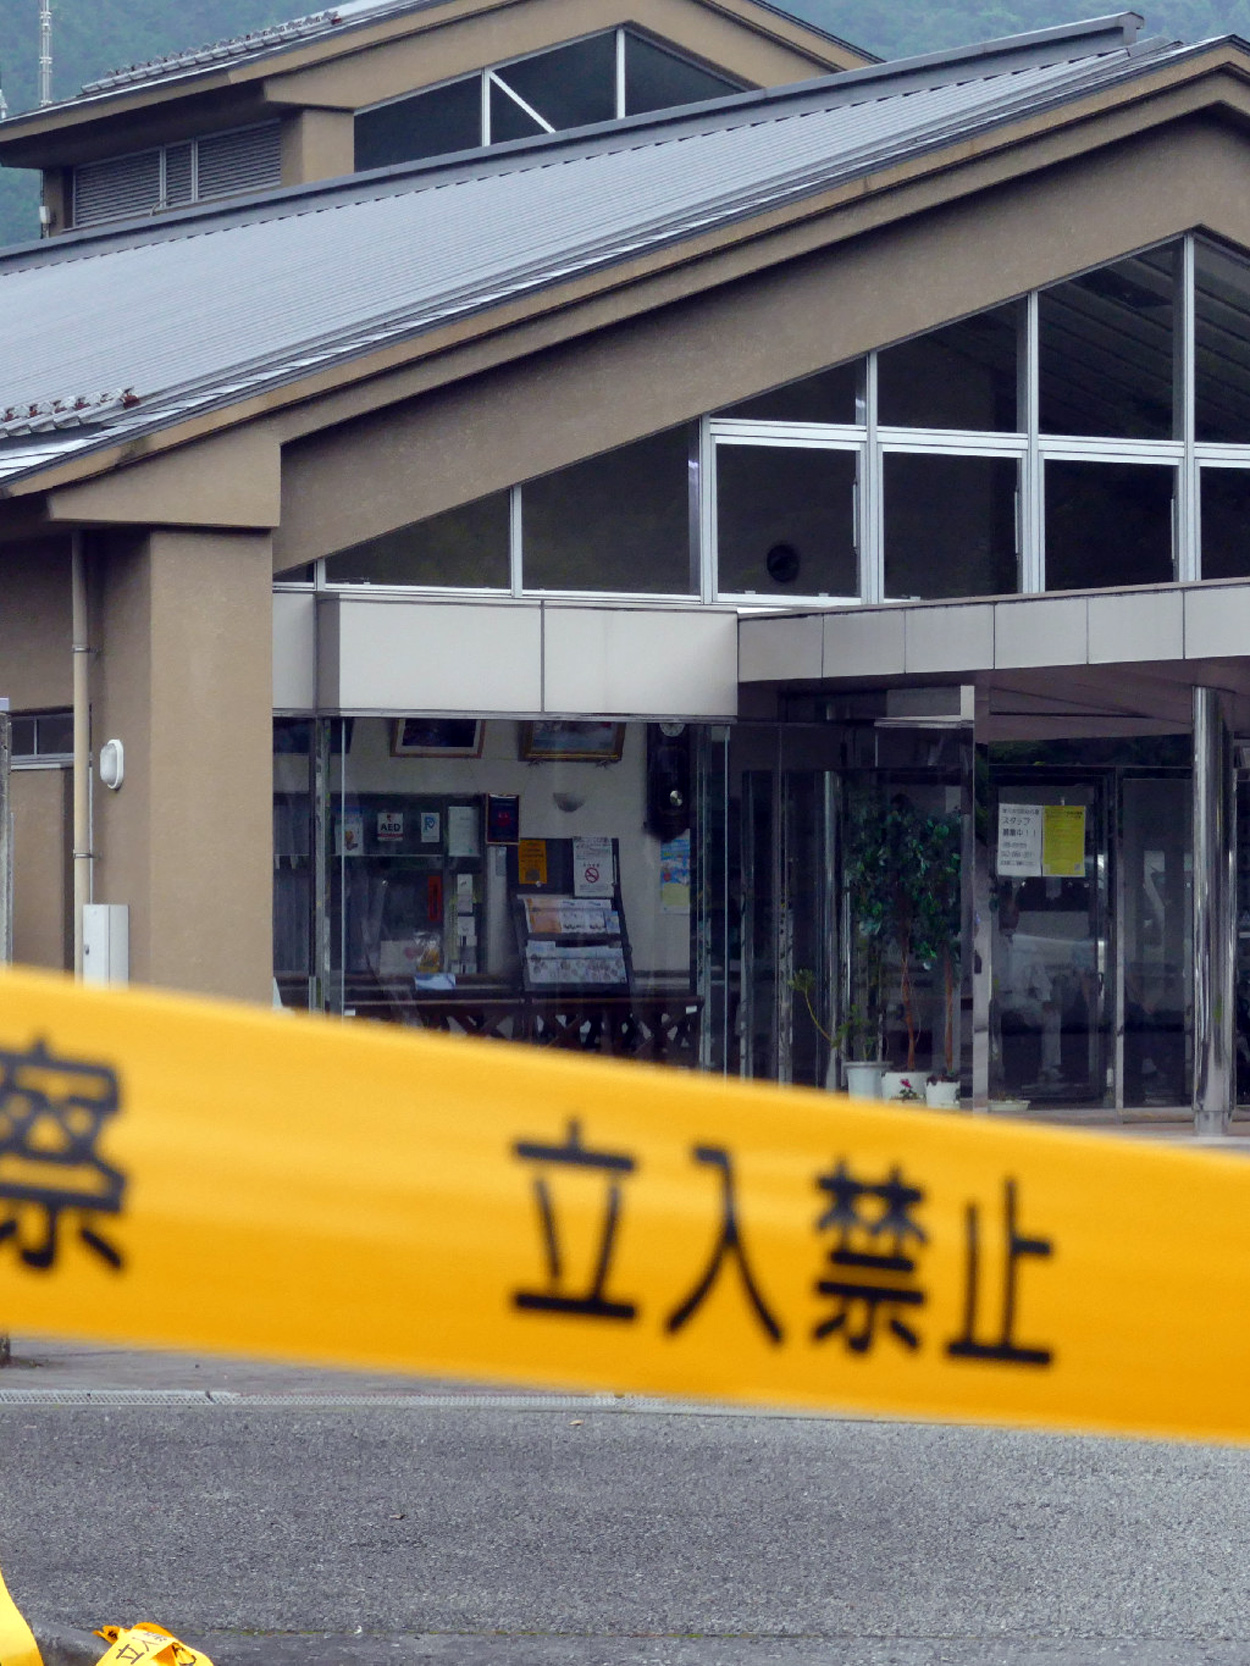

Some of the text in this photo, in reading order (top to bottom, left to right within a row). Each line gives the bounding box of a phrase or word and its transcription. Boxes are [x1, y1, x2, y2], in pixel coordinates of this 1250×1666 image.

[381, 823, 401, 832] AED
[511, 1117, 1053, 1368] 立入禁止
